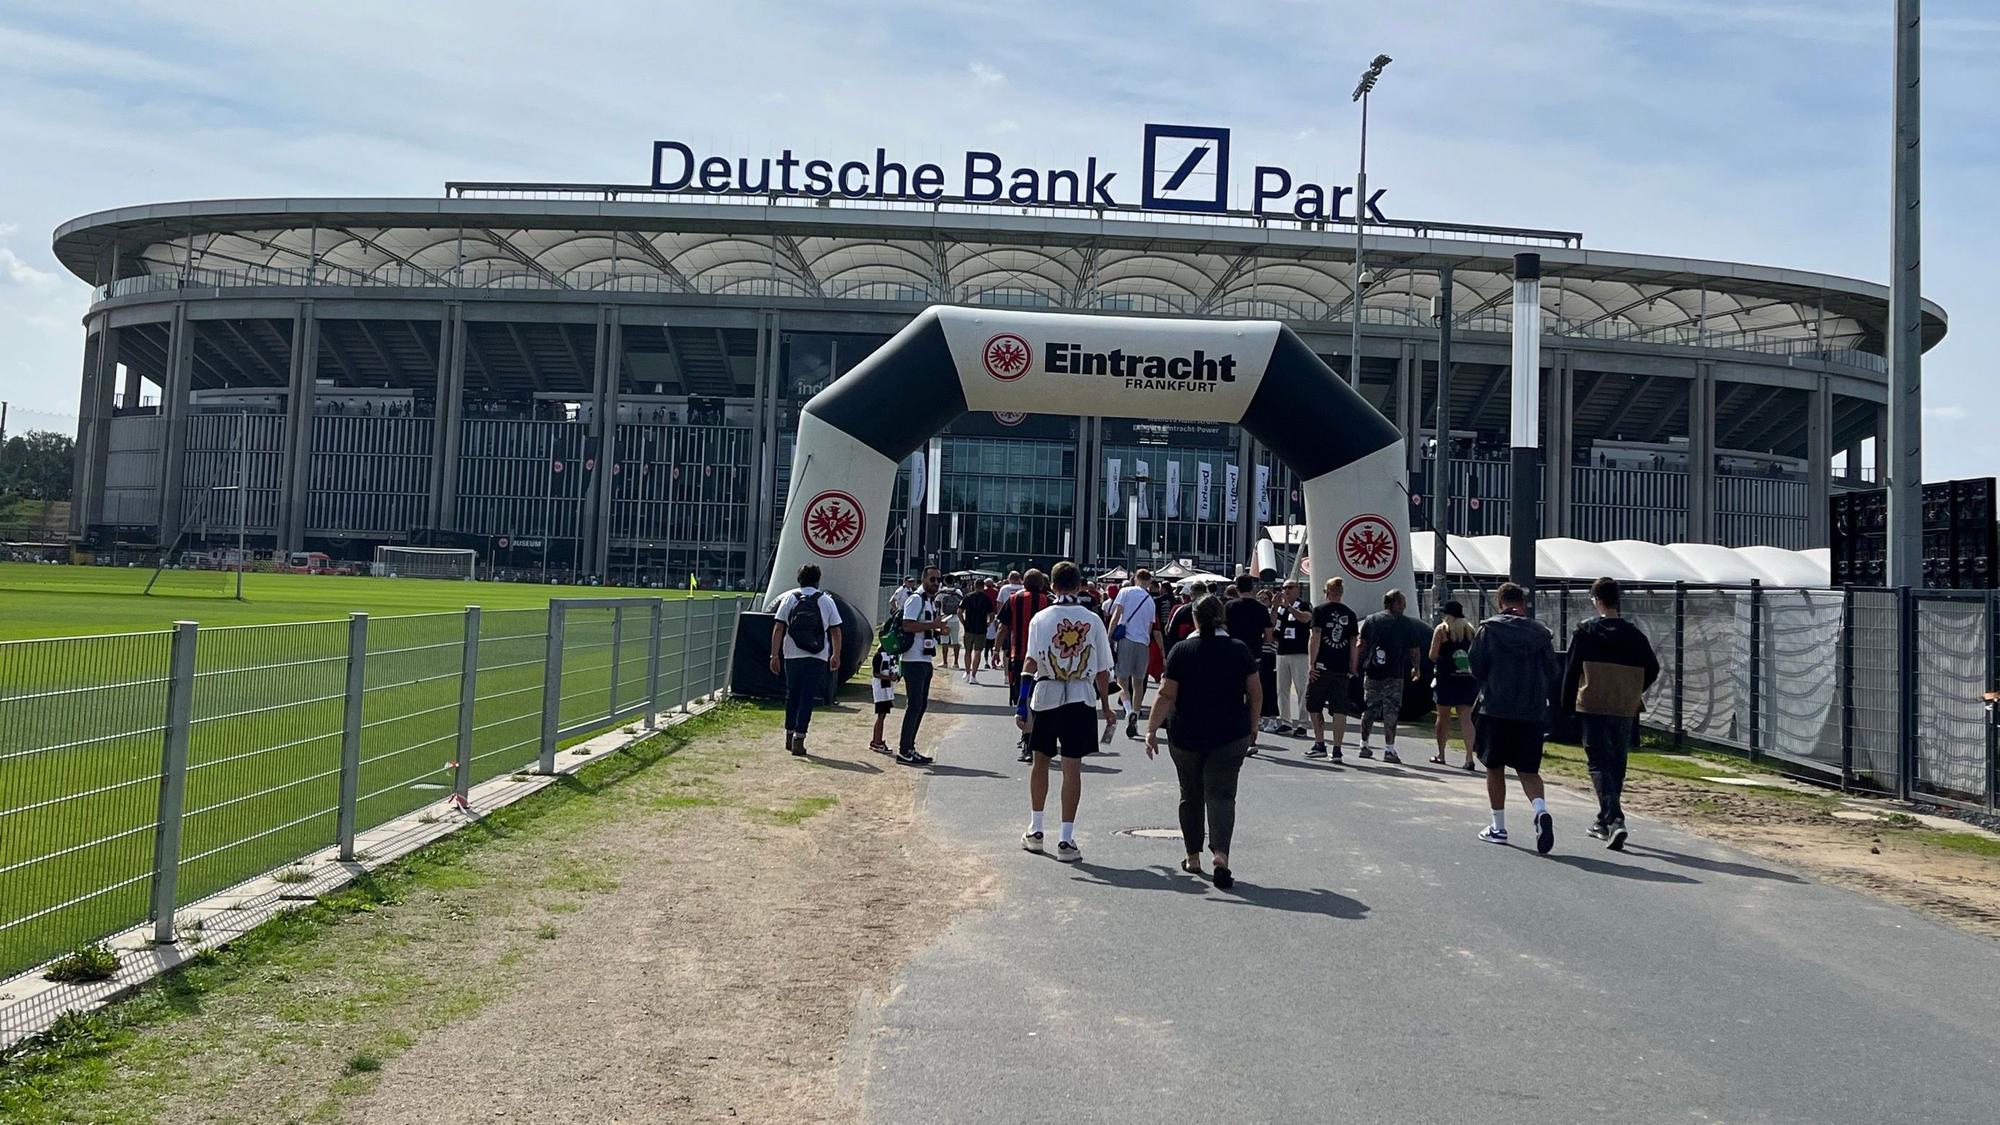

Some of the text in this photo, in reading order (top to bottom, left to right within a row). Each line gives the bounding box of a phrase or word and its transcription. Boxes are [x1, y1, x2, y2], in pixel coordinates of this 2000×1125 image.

[651, 140, 1389, 224] Deutsche Bank Park
[1045, 342, 1236, 382] Eintracht
[1125, 379, 1217, 393] FRANKFURT
[1197, 426, 1219, 434] Power
[1201, 470, 1210, 510] indeed
